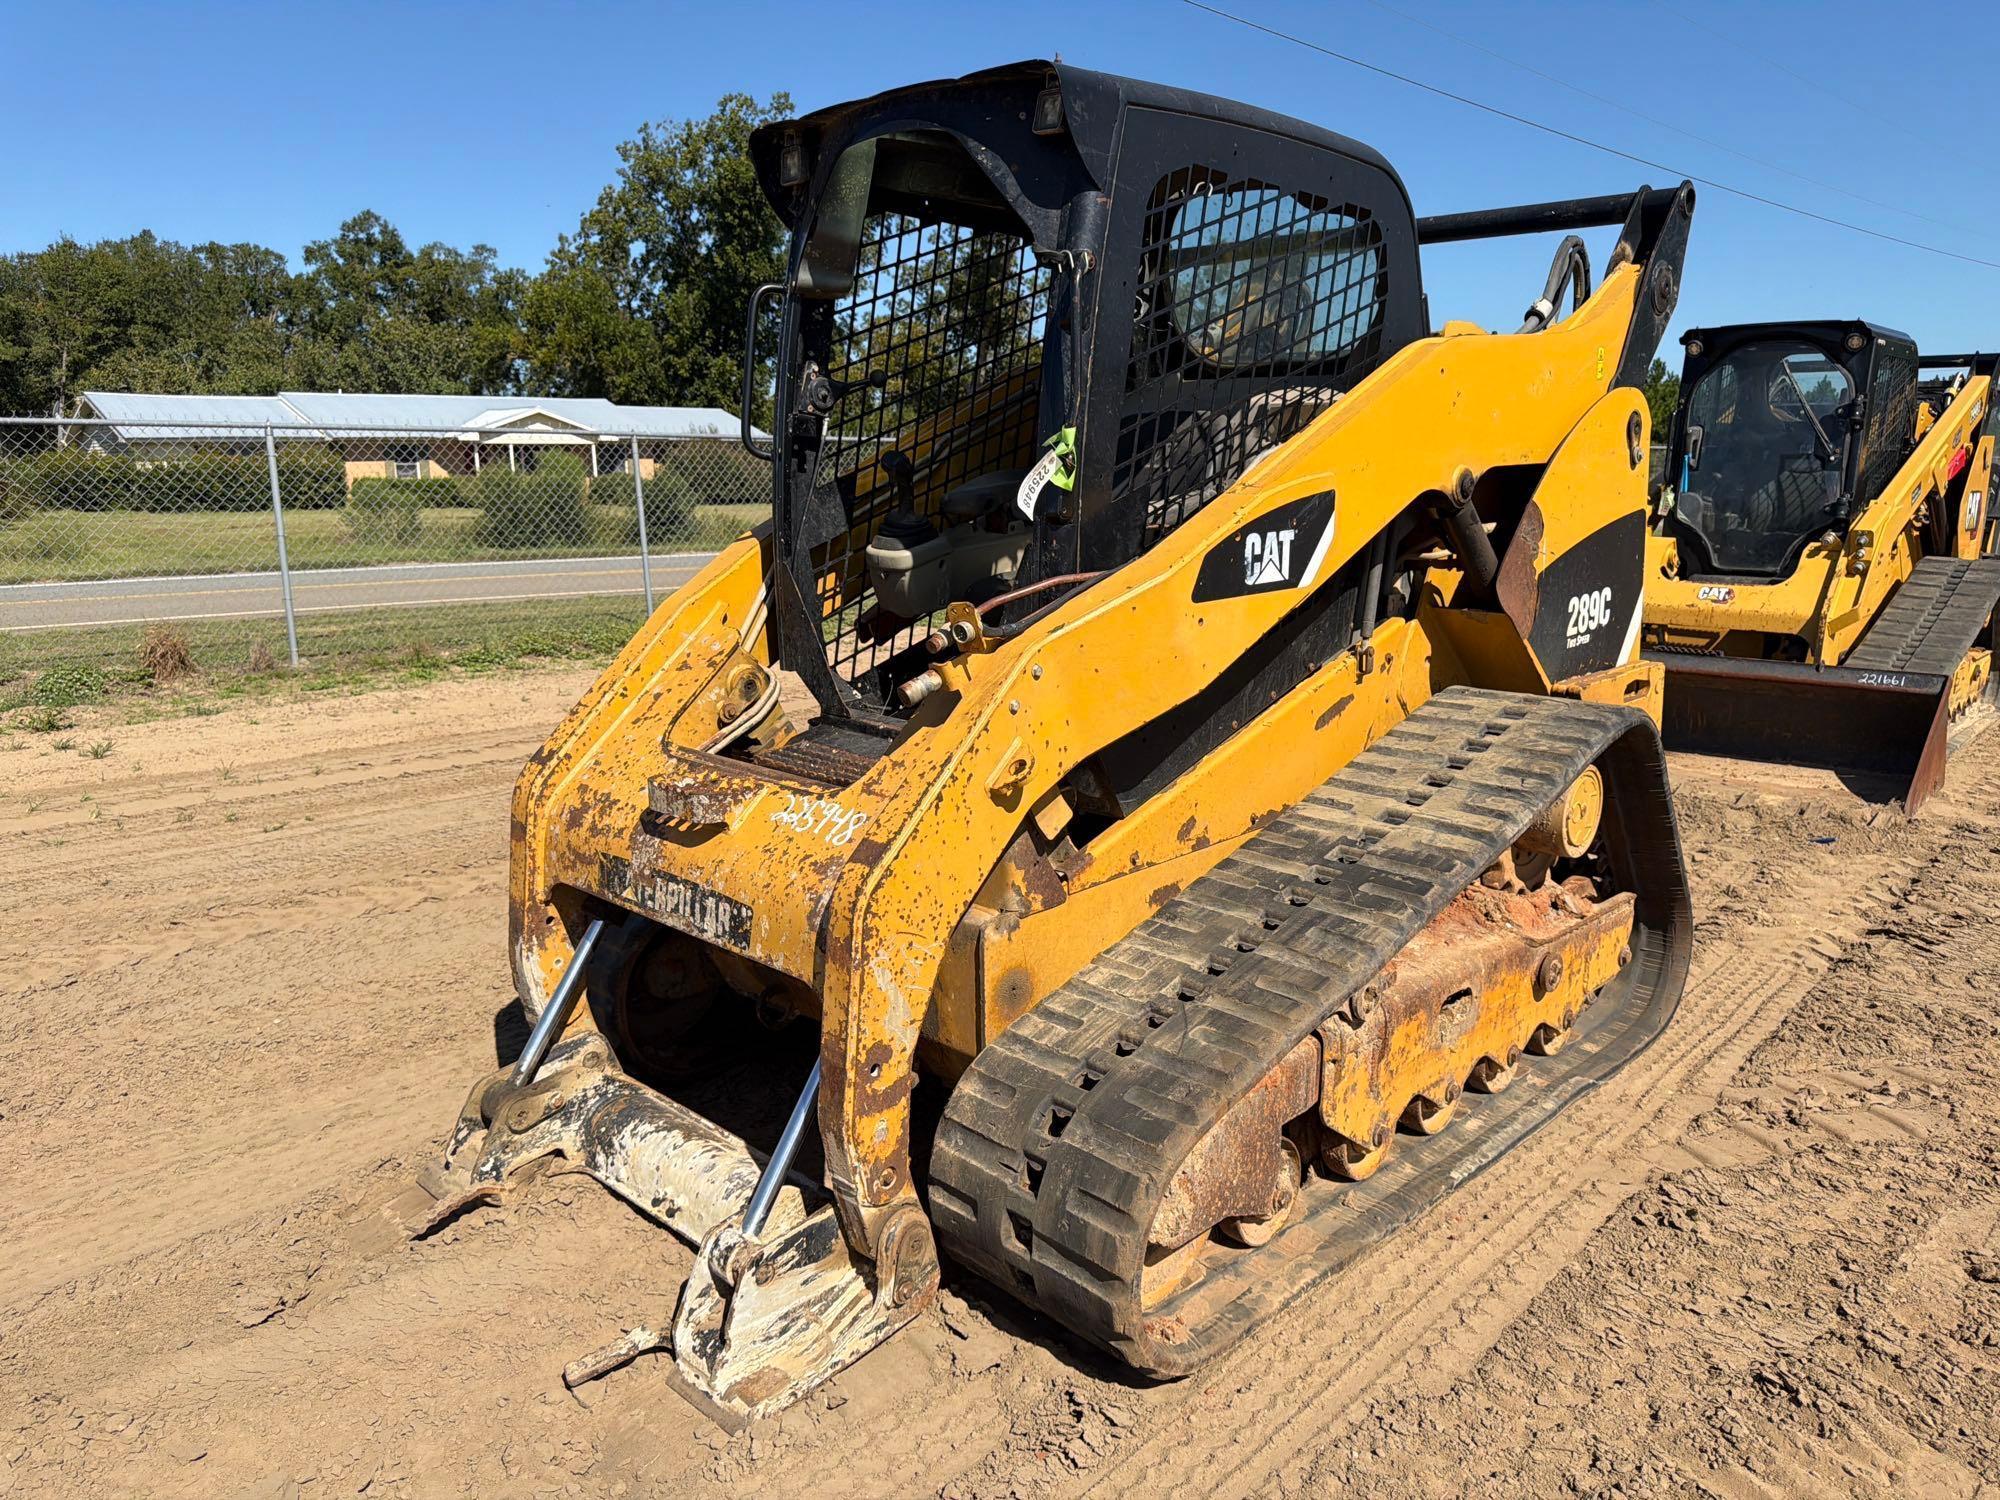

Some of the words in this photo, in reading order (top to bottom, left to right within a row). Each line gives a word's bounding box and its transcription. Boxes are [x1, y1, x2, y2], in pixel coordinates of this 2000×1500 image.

[1022, 464, 1050, 510] 225948
[1244, 529, 1295, 586] CAT
[1566, 586, 1612, 637] 289C
[1697, 586, 1730, 601] CAT
[1858, 673, 1906, 687] 221661
[604, 864, 732, 936] TERPILLAR
